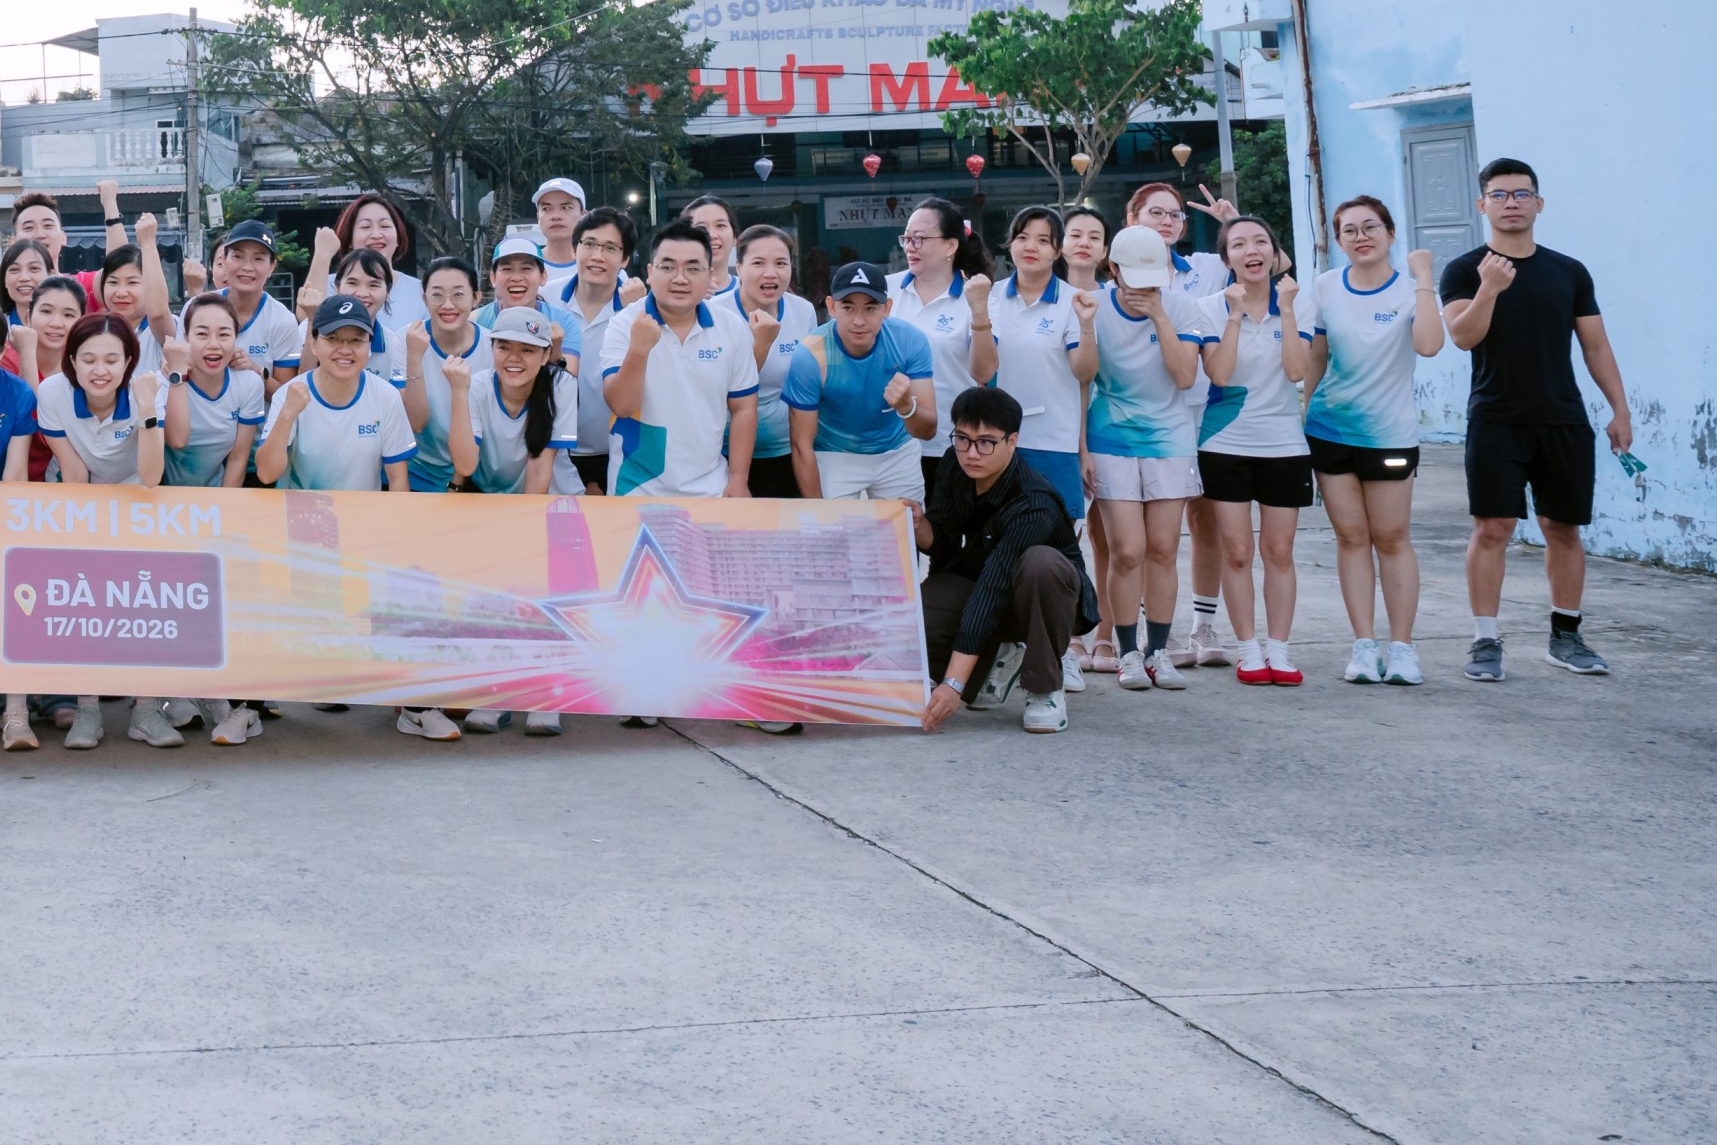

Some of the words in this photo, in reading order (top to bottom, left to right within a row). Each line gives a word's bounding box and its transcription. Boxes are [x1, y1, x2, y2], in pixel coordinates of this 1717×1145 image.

[685, 4, 722, 32] CƠ
[730, 27, 834, 41] HANDICRAFTS
[838, 24, 924, 38] SCULPTURE
[249, 345, 267, 354] BSC
[698, 349, 718, 359] BSC
[779, 343, 796, 353] BSC
[358, 424, 378, 434] BSC
[5, 499, 97, 533] 3KM
[130, 502, 221, 536] 5KM
[46, 572, 96, 607] ĐÀ
[106, 569, 209, 610] NẴNG
[44, 616, 178, 639] 17/10/2026
